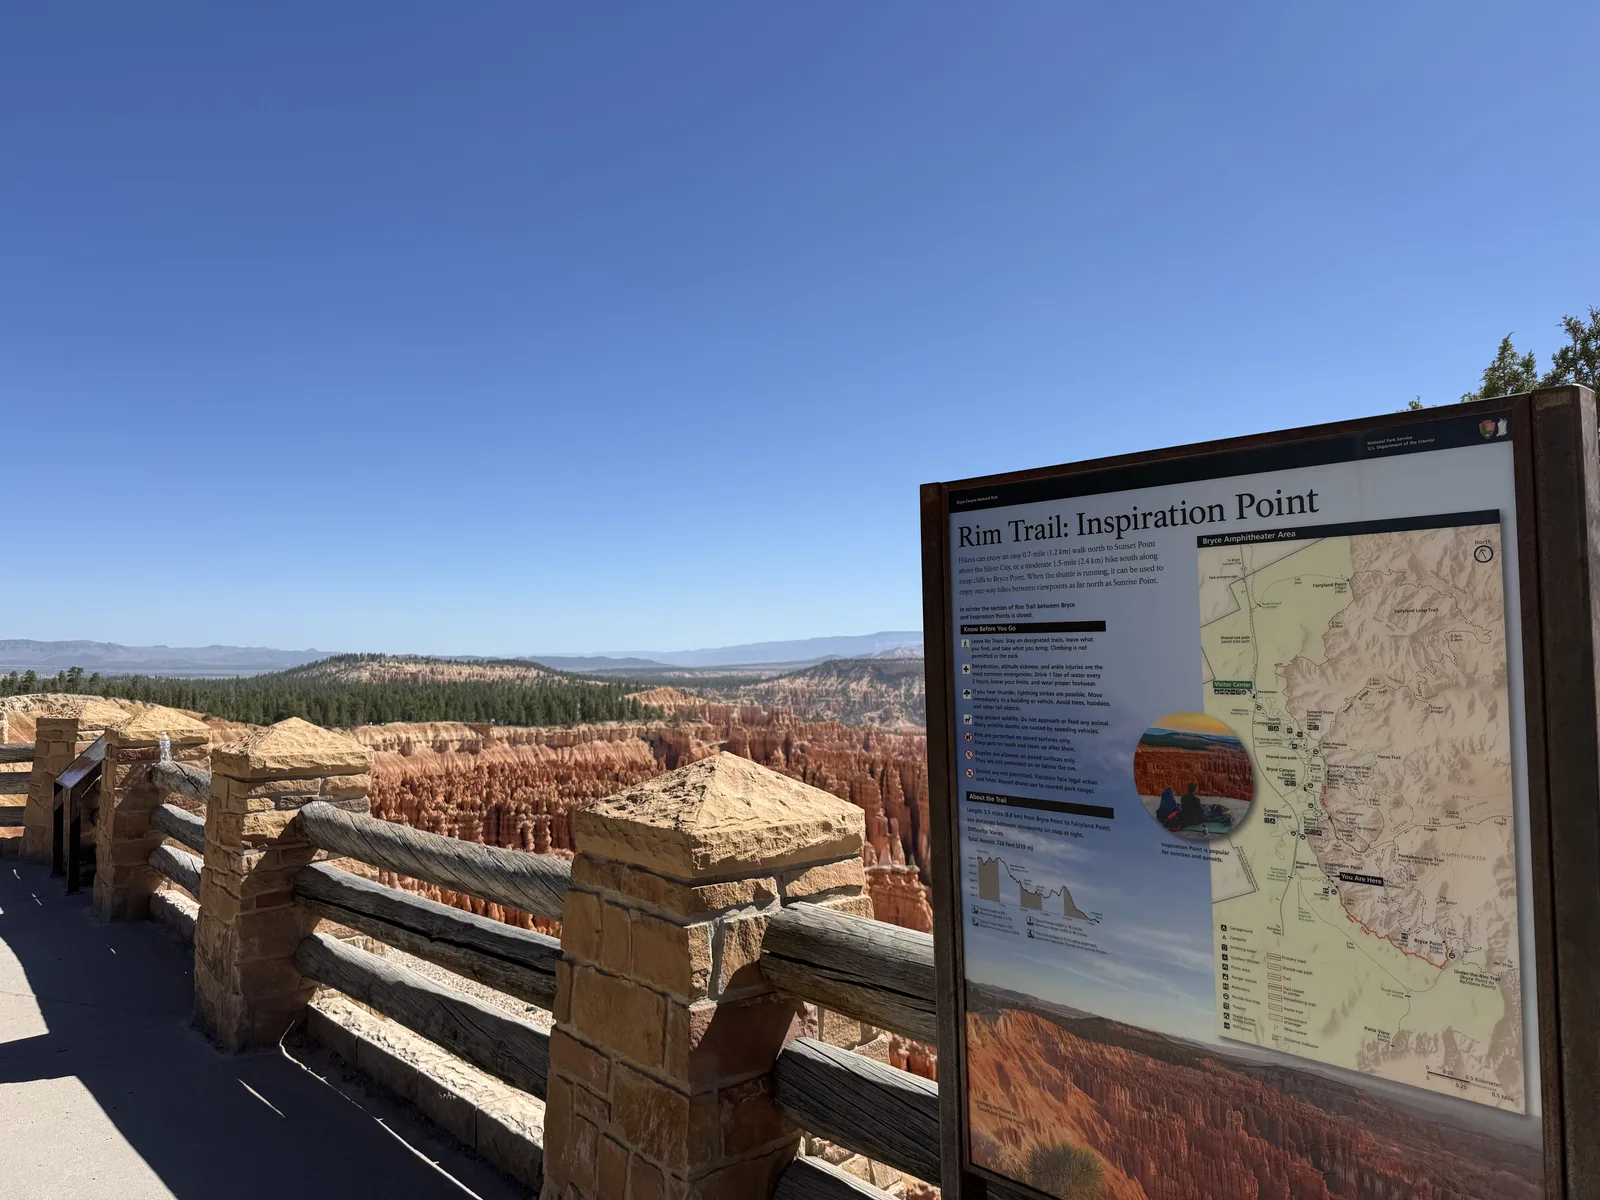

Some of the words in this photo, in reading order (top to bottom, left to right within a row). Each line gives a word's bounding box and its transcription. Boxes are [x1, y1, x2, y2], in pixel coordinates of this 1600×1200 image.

[958, 525, 1002, 548] Rim
[1008, 515, 1068, 543] Trail:
[1077, 500, 1226, 540] Inspiration
[1236, 488, 1319, 520] Point
[1202, 536, 1222, 546] Bryce
[1224, 532, 1275, 544] Amphitheater
[1278, 530, 1296, 538] Area
[958, 556, 975, 564] Hikers
[1022, 550, 1045, 558] 0.7-mile
[1047, 548, 1058, 558] (1.2
[1059, 547, 1071, 557] km)
[1072, 546, 1086, 554] walk
[1088, 544, 1105, 553] north
[1114, 542, 1136, 551] Sunset
[1138, 540, 1156, 549] Point
[1000, 563, 1012, 573] City,
[1025, 560, 1052, 569] moderate
[1053, 558, 1077, 567] 1.5-mile
[1078, 557, 1090, 567] (2.4
[1090, 556, 1104, 566] km)
[1104, 555, 1118, 563] hike
[1119, 553, 1138, 562] south
[1139, 552, 1158, 562] along
[959, 577, 972, 586] steep
[993, 574, 1008, 584] Bryce
[1027, 572, 1044, 580] When
[1055, 570, 1075, 578] shuttle
[1083, 567, 1109, 578] running,
[1129, 565, 1138, 573] be
[1139, 564, 1155, 573] used
[1156, 564, 1163, 572] to
[1012, 584, 1035, 592] between
[1037, 582, 1068, 592] viewpoints
[1086, 580, 1104, 588] north
[1113, 578, 1137, 586] Sunrise
[1139, 576, 1158, 585] Point.
[1061, 602, 1076, 610] Bryce
[966, 807, 983, 816] Length:
[1014, 813, 1023, 821] km)
[1036, 816, 1049, 824] Bryce
[1071, 820, 1094, 830] Fairyland
[1095, 823, 1111, 833] Point;
[975, 817, 995, 826] distances
[996, 820, 1016, 829] between
[1017, 823, 1043, 834] viewpoints
[1070, 830, 1084, 839] right.
[1161, 842, 1188, 850] Inspiration
